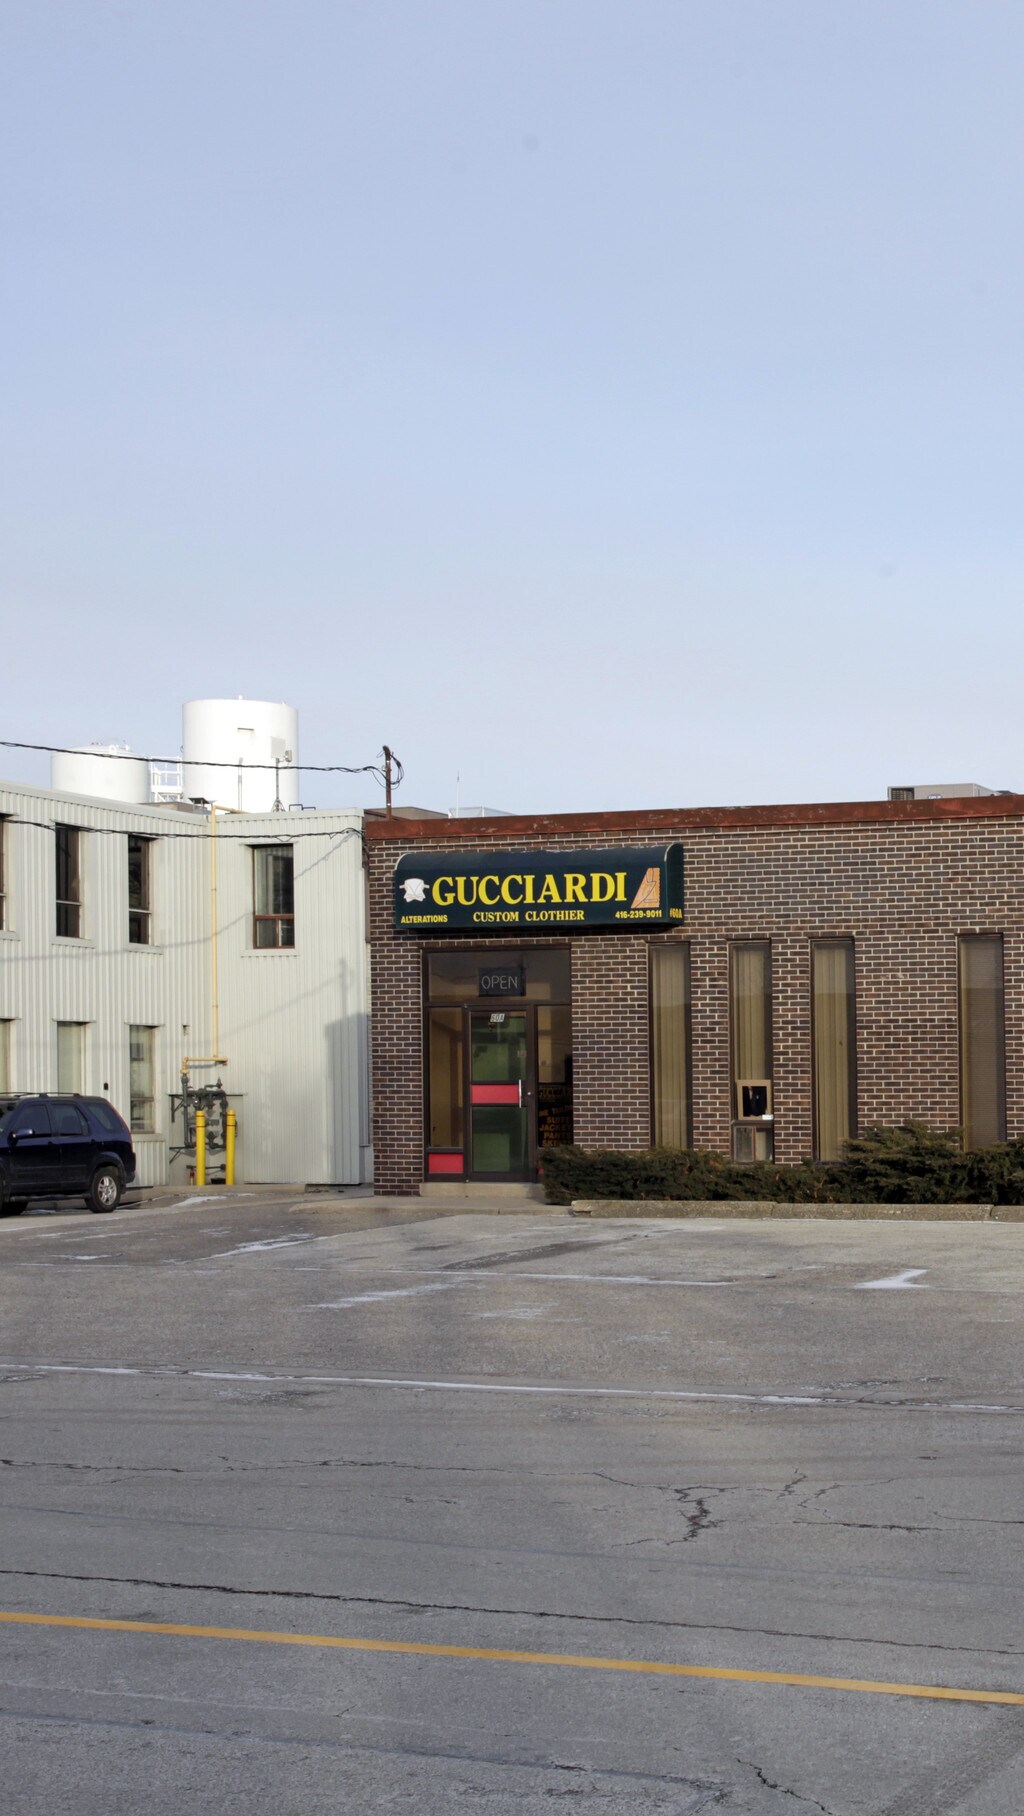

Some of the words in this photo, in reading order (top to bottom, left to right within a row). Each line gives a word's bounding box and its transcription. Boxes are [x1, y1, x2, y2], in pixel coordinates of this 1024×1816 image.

[431, 872, 627, 906] GUCCIARDI
[400, 914, 448, 924] ALTERATIONS
[473, 911, 519, 922] CUSTOM
[525, 910, 585, 921] CLOTHIER
[615, 910, 663, 919] 416-239-9011
[481, 975, 518, 990] OPEN
